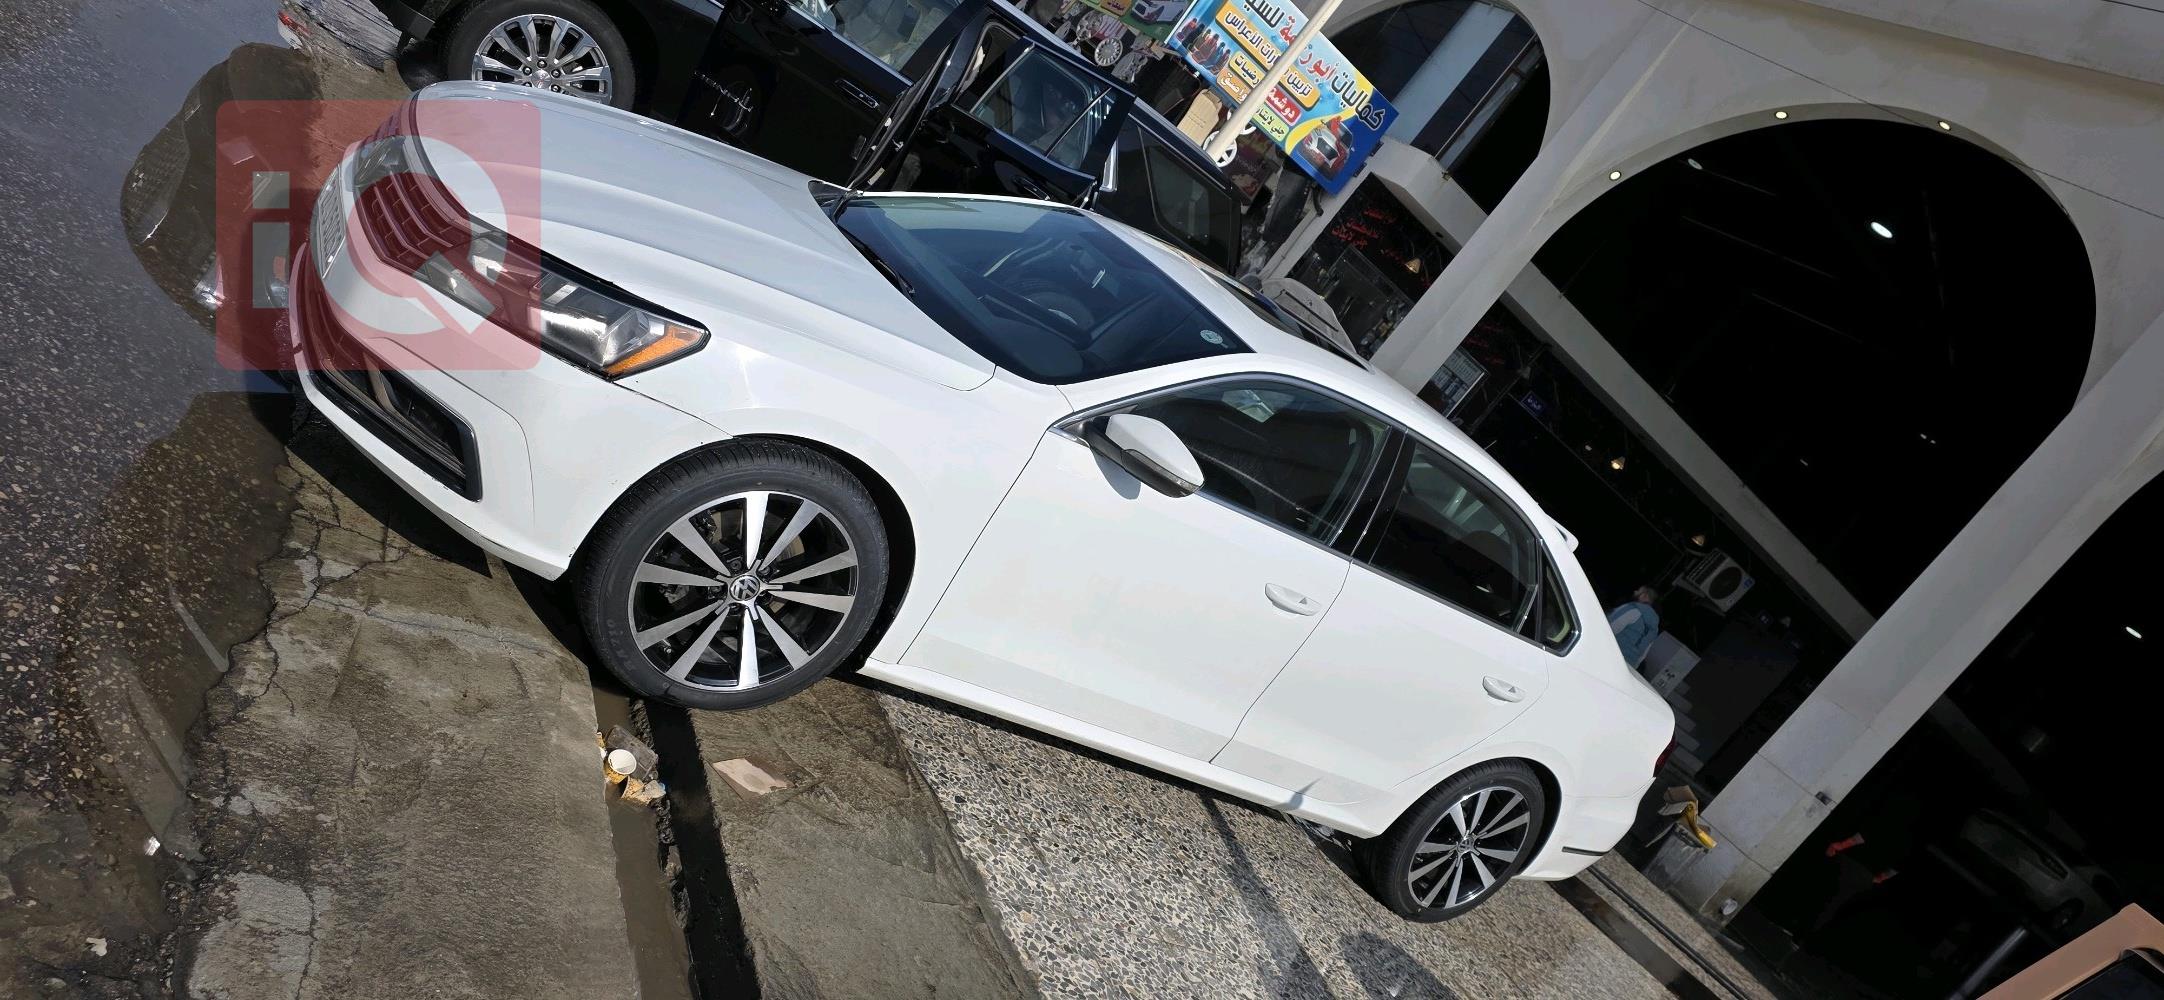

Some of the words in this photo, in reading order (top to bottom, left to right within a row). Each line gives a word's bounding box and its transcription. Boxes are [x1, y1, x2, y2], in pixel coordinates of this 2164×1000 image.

[1243, 0, 1285, 28] للسي
[1234, 55, 1260, 85] رضيات
[1287, 72, 1313, 97] تزيين
[1307, 59, 1340, 83] أبو
[1220, 71, 1248, 102] واصق
[1331, 71, 1386, 130] كماليات
